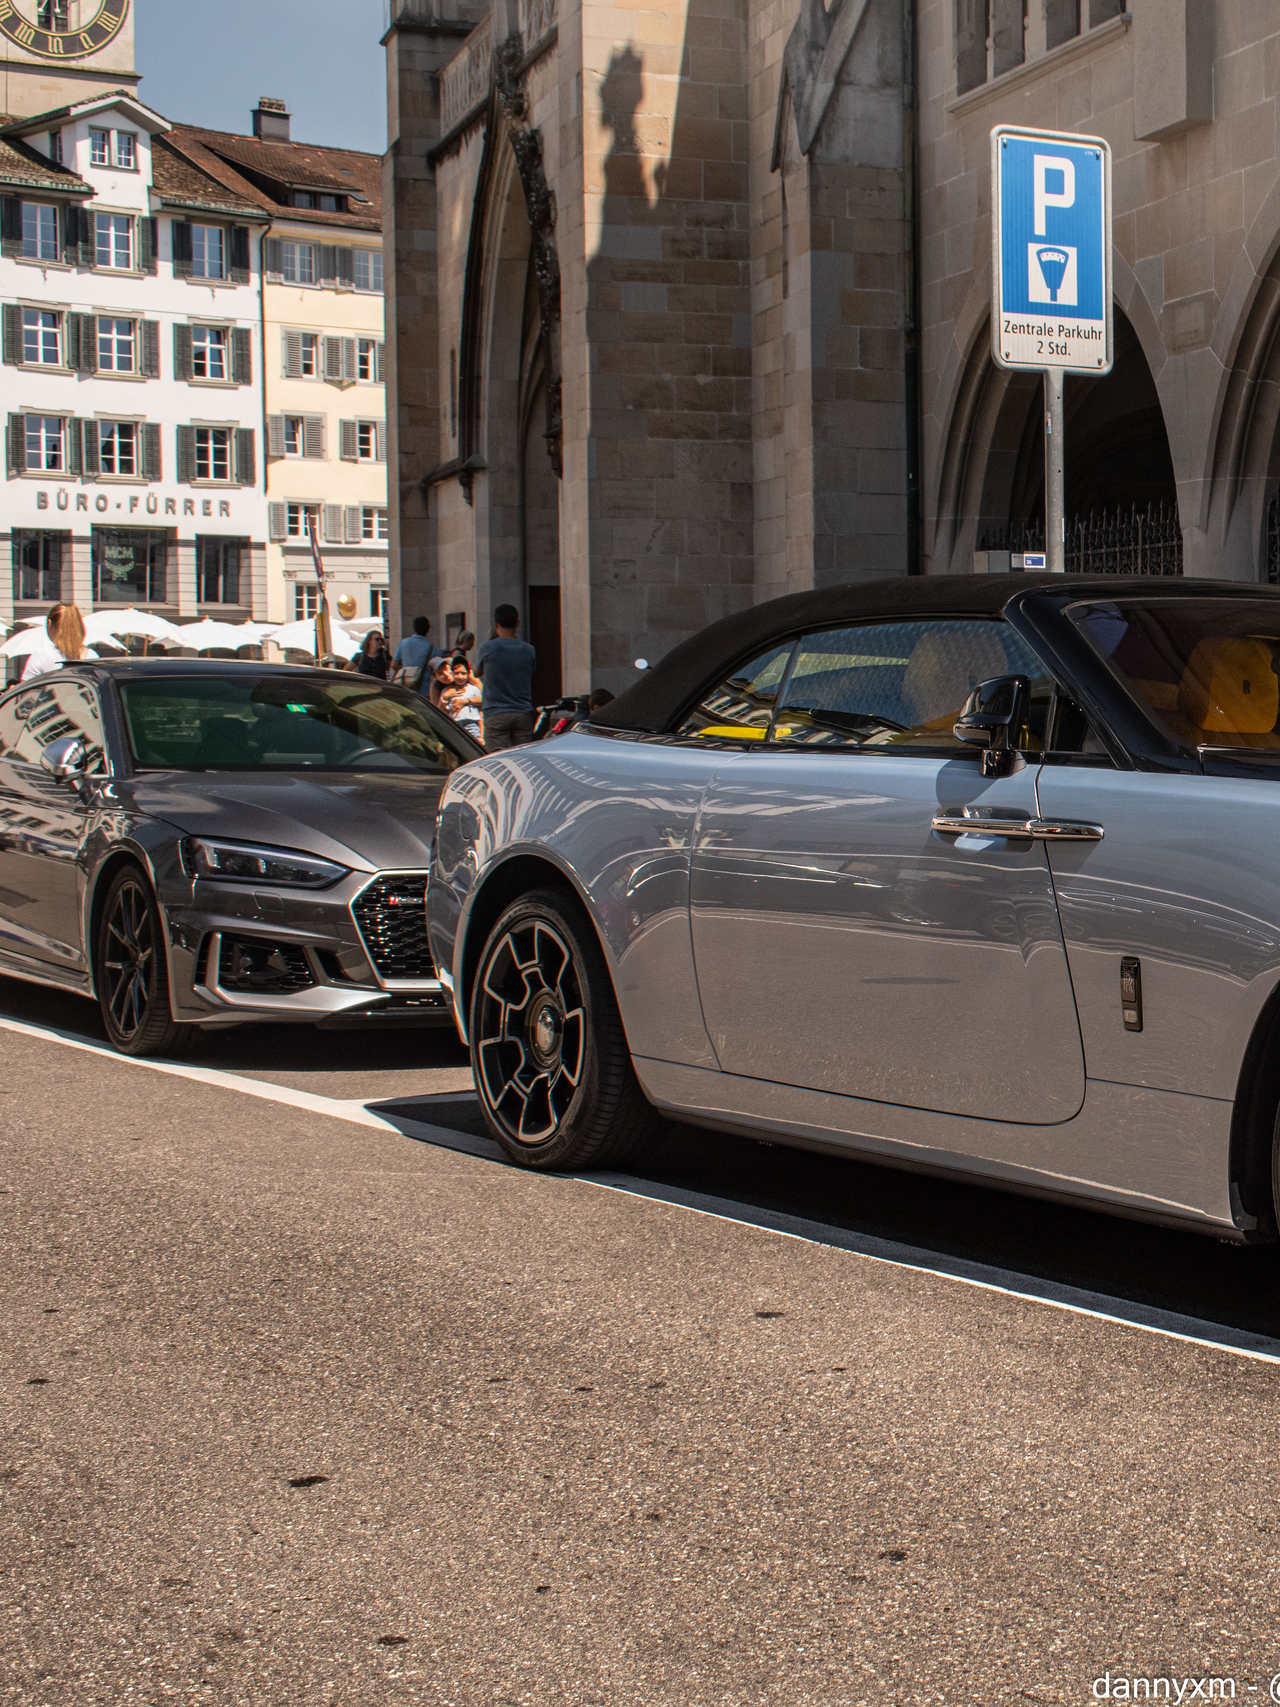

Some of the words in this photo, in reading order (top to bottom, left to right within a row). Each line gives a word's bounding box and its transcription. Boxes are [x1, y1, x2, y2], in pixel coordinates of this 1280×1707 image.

[1033, 153, 1076, 237] P
[1003, 319, 1055, 337] Zentrale
[1057, 324, 1103, 341] Parkuhr
[1037, 340, 1044, 354] 2
[1048, 341, 1072, 356] Std.
[104, 546, 135, 559] MCM
